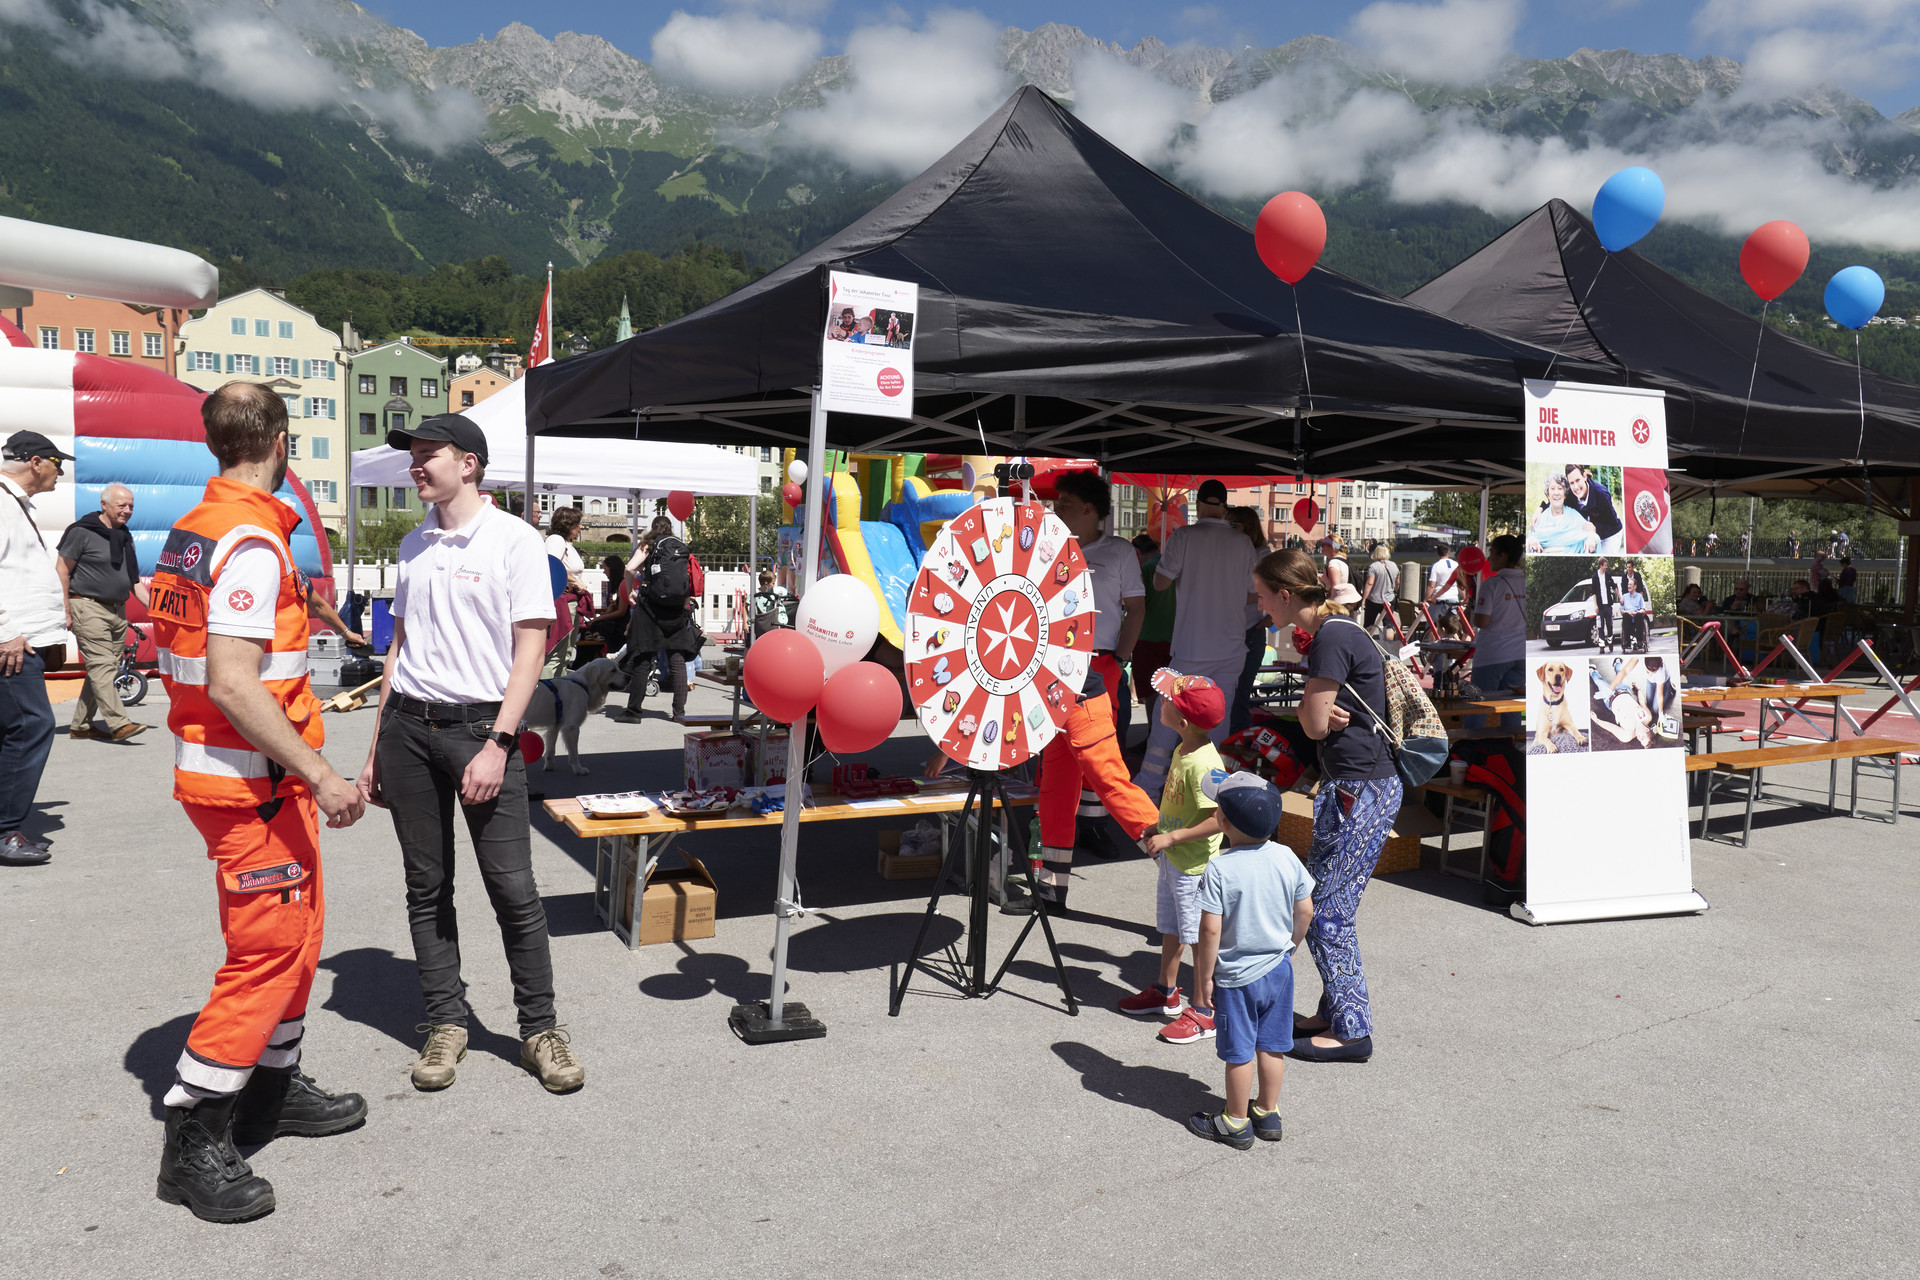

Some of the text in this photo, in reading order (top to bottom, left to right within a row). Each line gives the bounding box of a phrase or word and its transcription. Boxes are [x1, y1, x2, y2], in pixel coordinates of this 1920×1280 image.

[1539, 407, 1558, 424] DIE
[1537, 426, 1616, 447] JOHANNITER
[994, 506, 1004, 517] 14
[1025, 508, 1034, 519] 15
[964, 518, 975, 531] 13
[1051, 524, 1059, 536] 16
[938, 546, 948, 559] 12
[1070, 552, 1079, 562] 17
[920, 587, 929, 597] 11
[1083, 588, 1088, 599] 18
[967, 586, 994, 645] UNFALL
[807, 623, 838, 638] JOHANNITER
[912, 631, 920, 643] 10
[970, 659, 1000, 692] HILFE
[1061, 704, 1067, 712] 3
[930, 715, 938, 724] 8
[1039, 733, 1043, 741] 4
[952, 741, 960, 751] 7
[1011, 749, 1016, 758] 5
